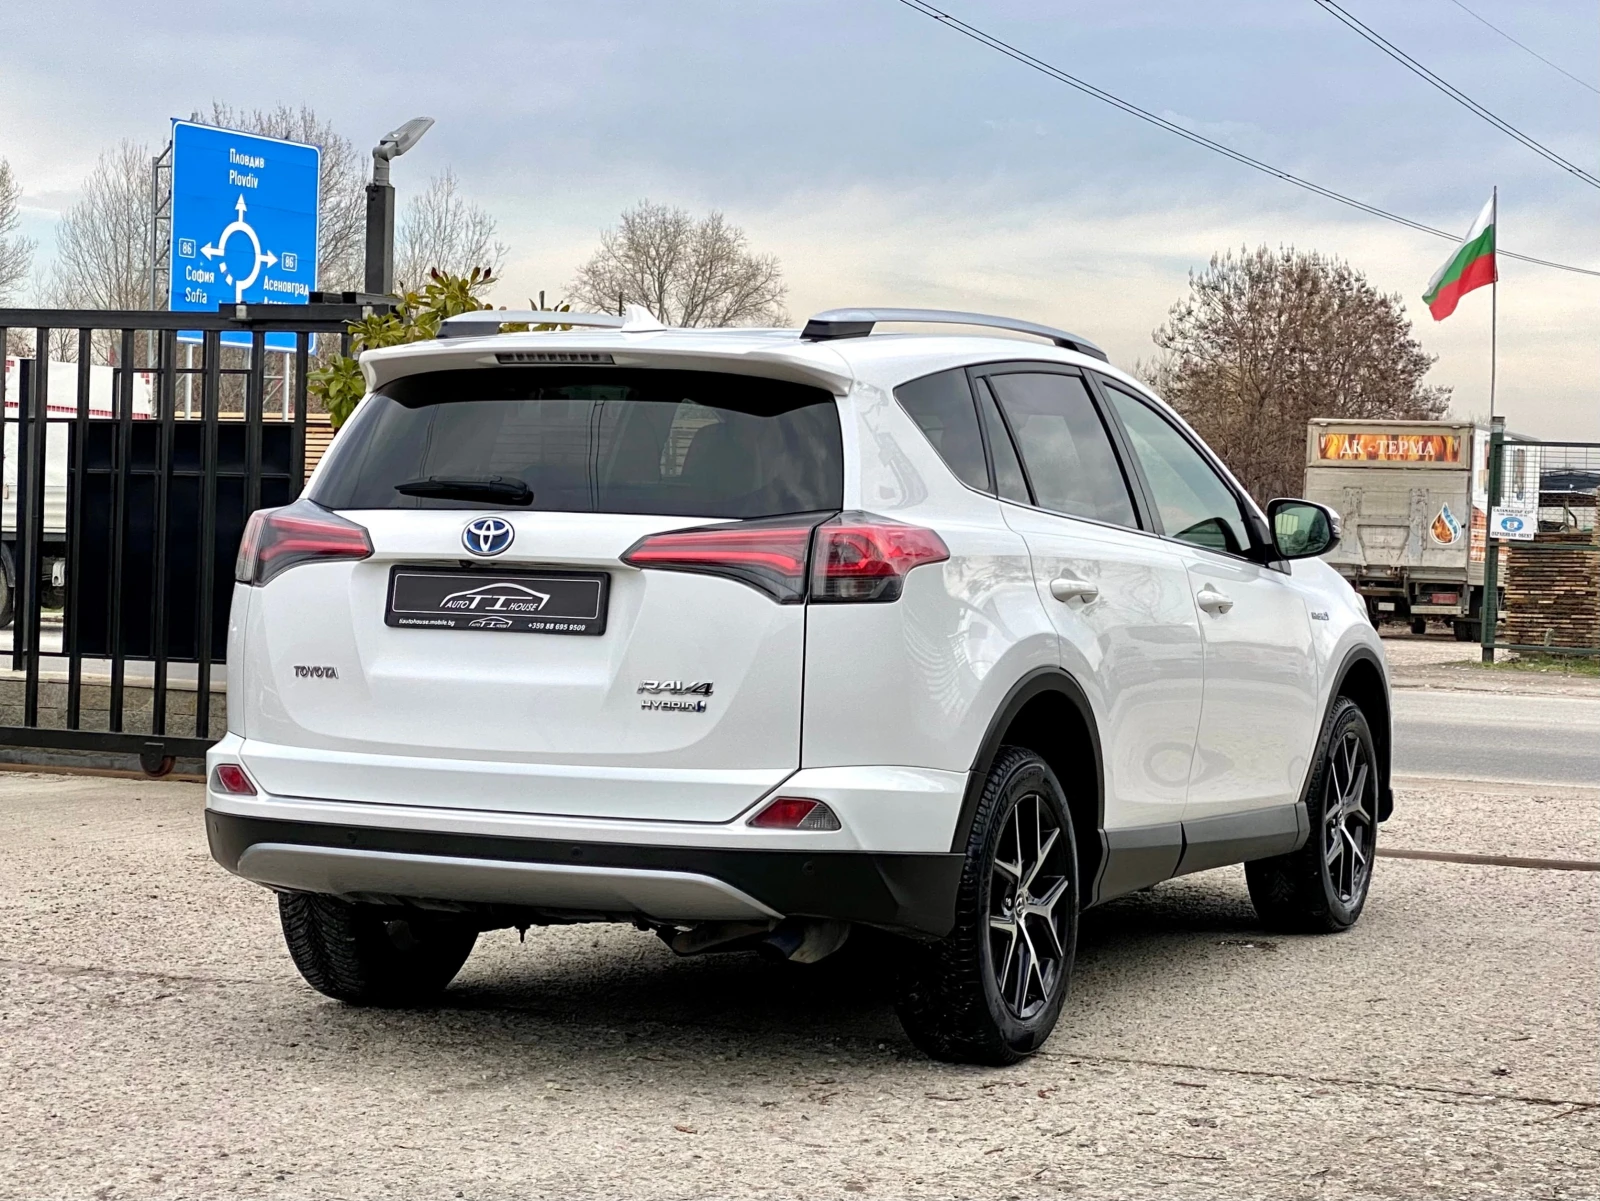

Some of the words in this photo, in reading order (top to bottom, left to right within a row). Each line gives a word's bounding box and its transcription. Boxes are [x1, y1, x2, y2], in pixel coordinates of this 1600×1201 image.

[229, 148, 265, 169] Пловдив
[229, 169, 259, 189] Plovdiv
[182, 242, 192, 255] 86
[285, 256, 294, 268] 86
[185, 266, 215, 284] София
[263, 275, 309, 297] Асеновград
[185, 288, 207, 304] Sofia
[1375, 440, 1435, 456] ТЕРМА
[445, 600, 469, 608] AUTO
[508, 602, 539, 612] HOUSE
[528, 622, 545, 630] +359
[555, 623, 568, 631] 695
[293, 665, 338, 680] TOYOTA
[637, 680, 714, 697] RAV4
